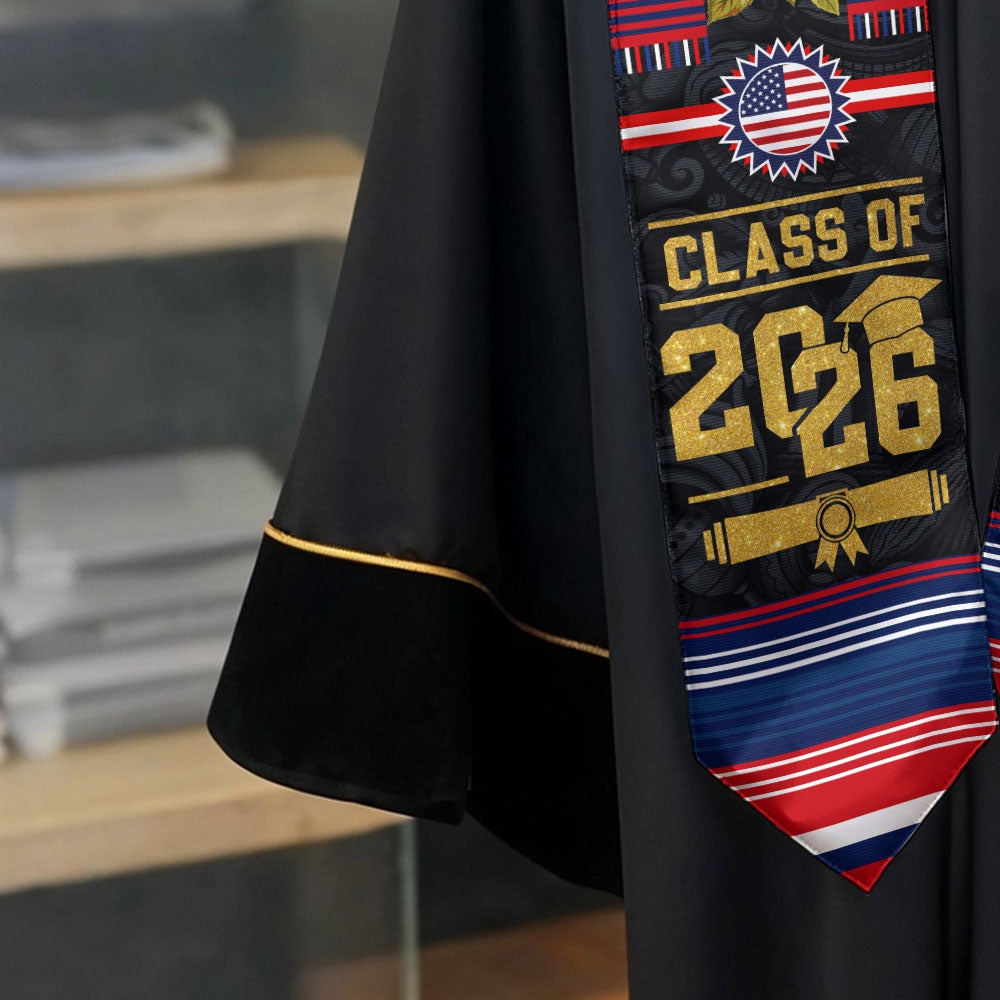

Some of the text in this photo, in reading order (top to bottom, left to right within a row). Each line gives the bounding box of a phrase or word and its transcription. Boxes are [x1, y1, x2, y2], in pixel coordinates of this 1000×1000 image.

[663, 194, 926, 292] CLASS OF
[660, 305, 942, 477] 2026
